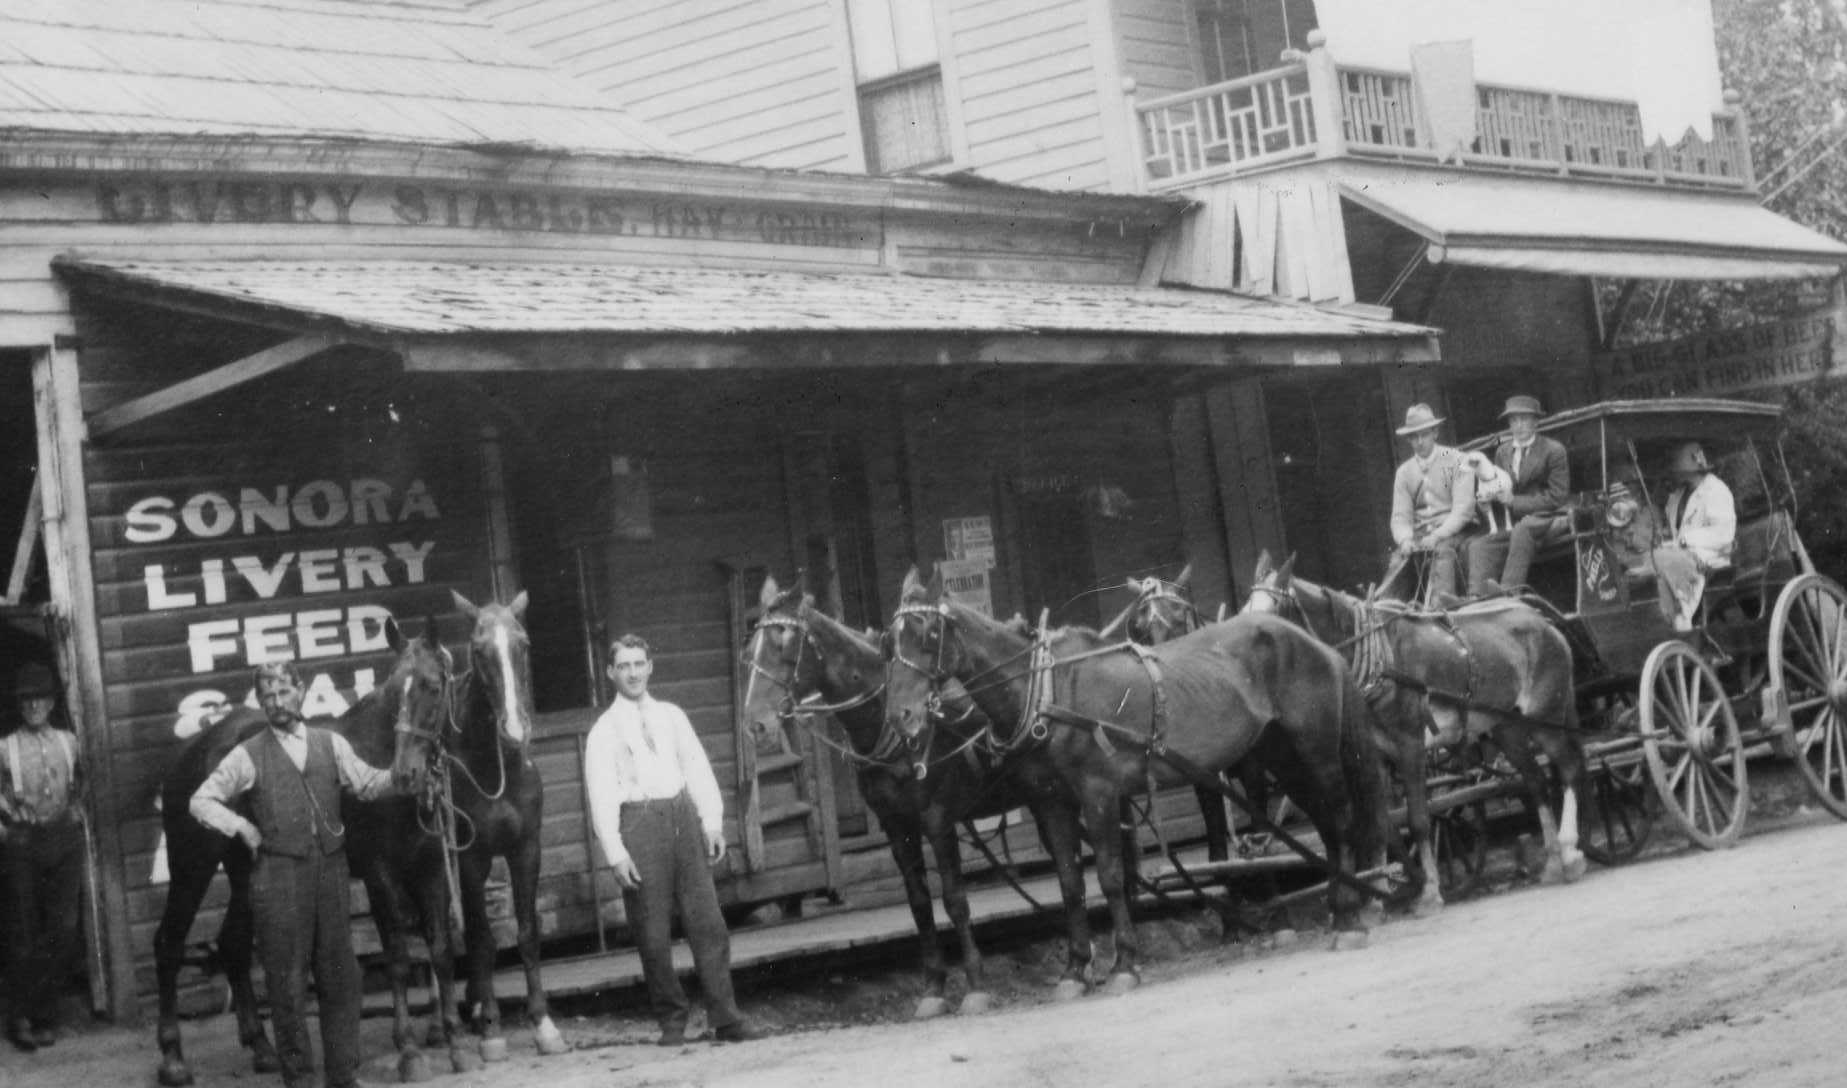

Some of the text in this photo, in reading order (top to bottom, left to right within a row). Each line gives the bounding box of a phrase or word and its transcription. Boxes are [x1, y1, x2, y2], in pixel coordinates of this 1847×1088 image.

[124, 479, 441, 543] SONORA
[144, 541, 437, 610] LIVERY
[187, 604, 398, 673] FEED
